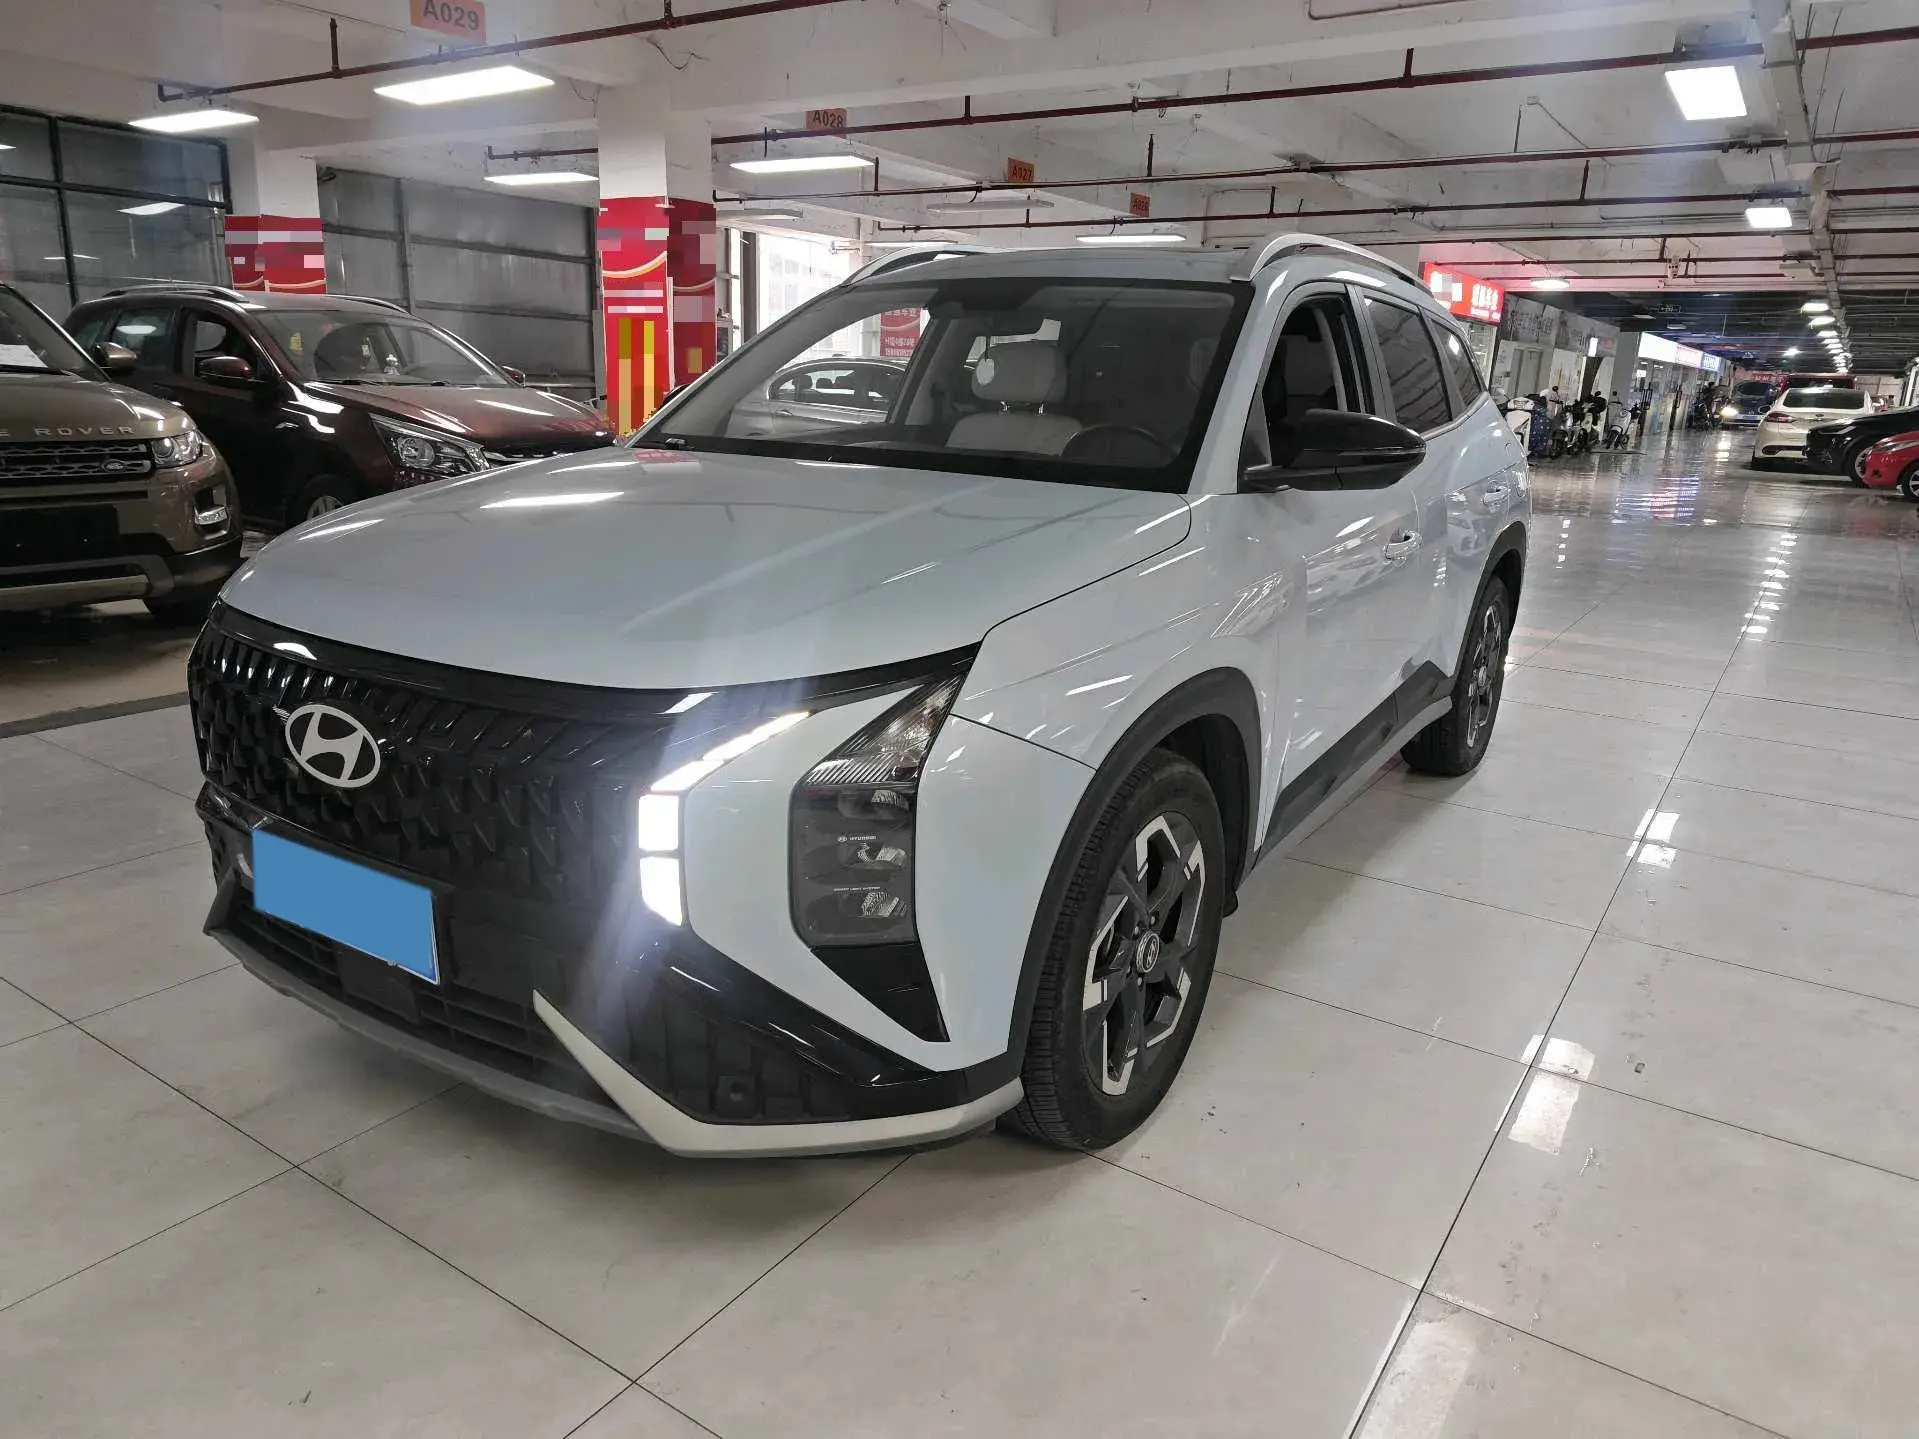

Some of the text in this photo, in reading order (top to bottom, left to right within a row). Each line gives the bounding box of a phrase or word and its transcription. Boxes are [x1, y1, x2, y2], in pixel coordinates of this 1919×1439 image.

[423, 0, 479, 31] A029
[812, 110, 844, 128] A028
[34, 426, 134, 436] ROVER
